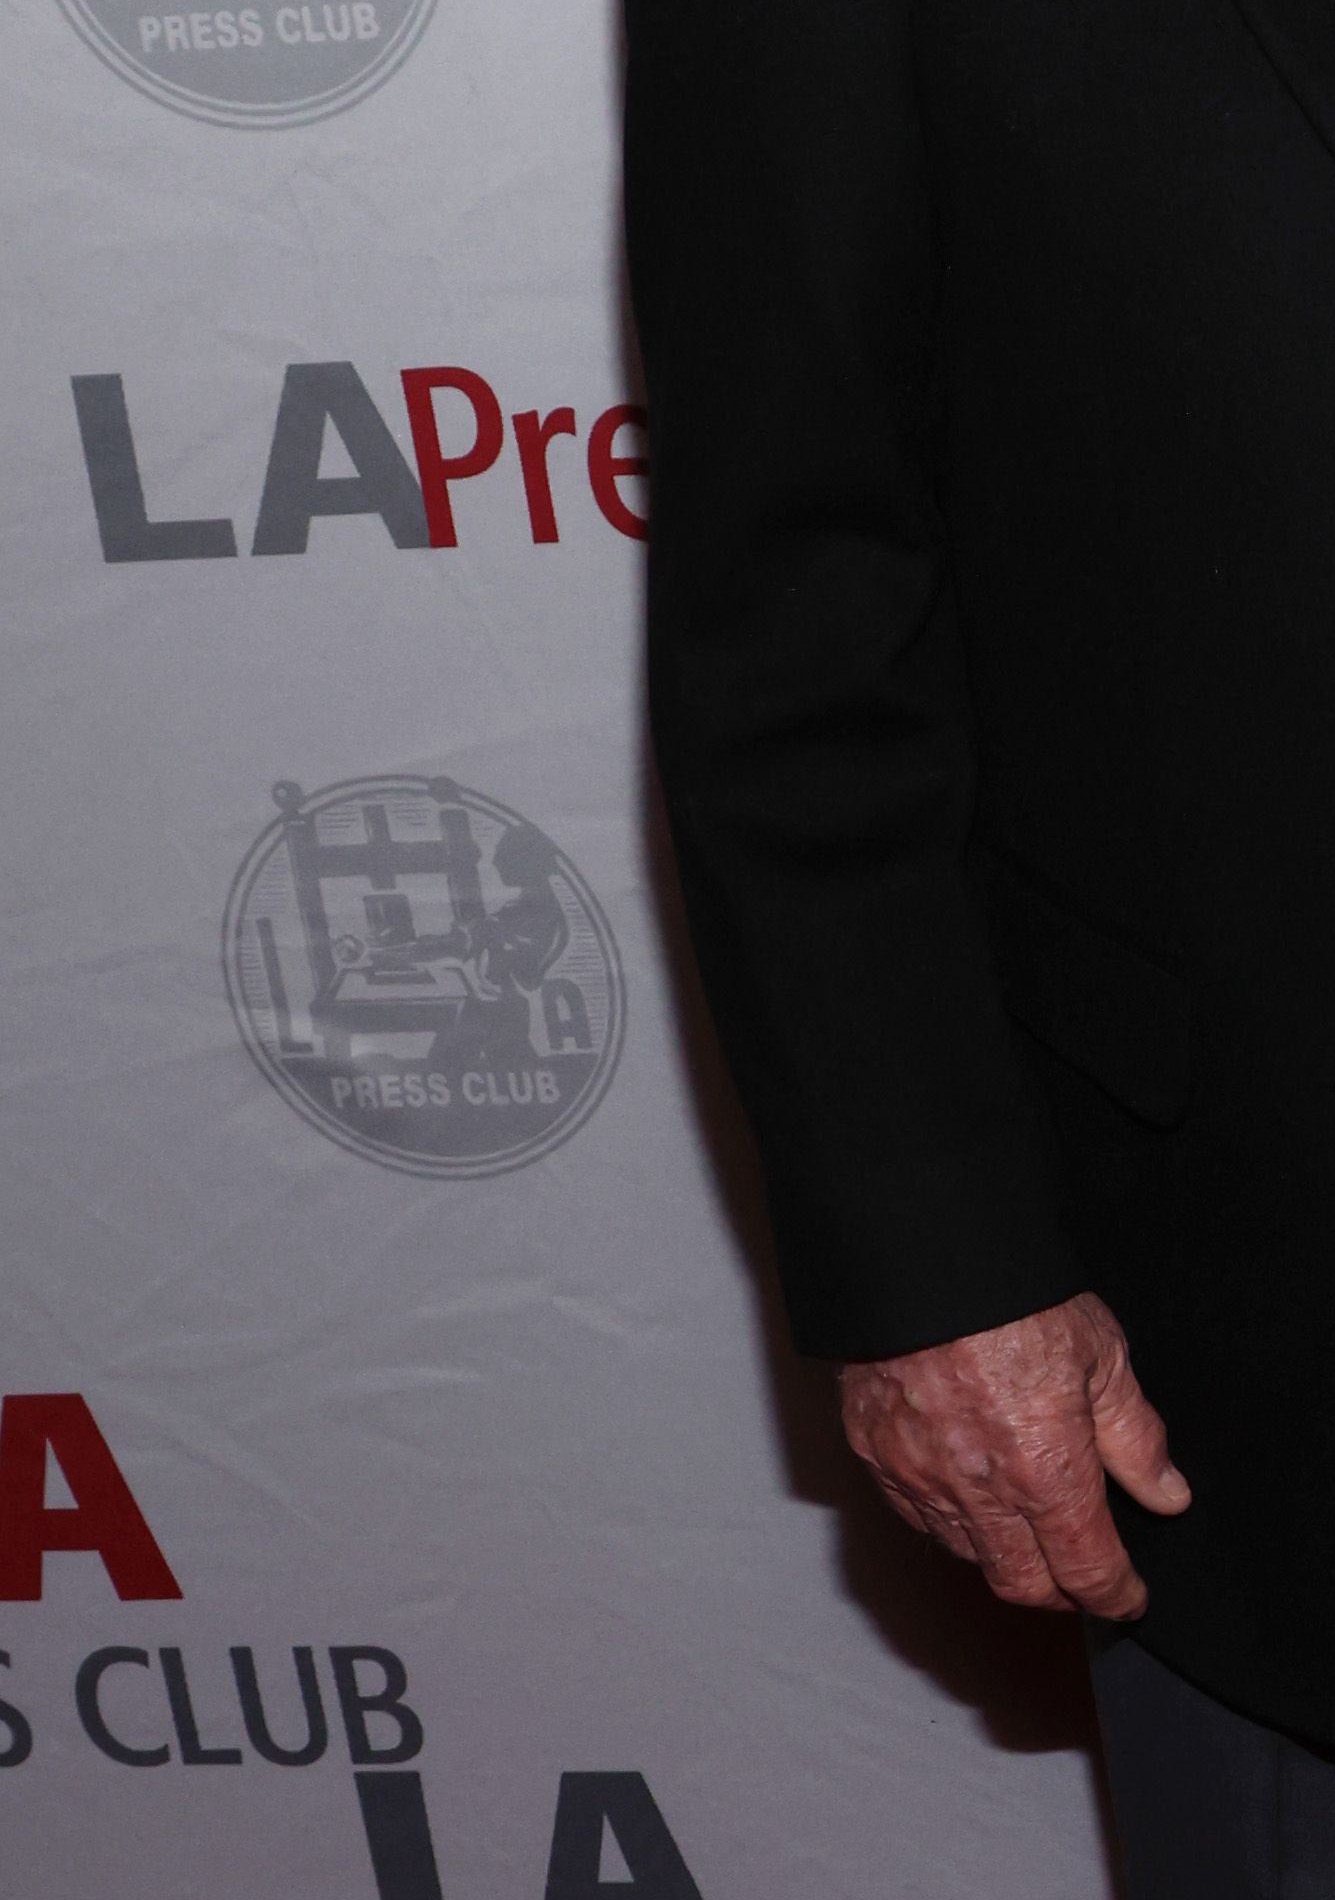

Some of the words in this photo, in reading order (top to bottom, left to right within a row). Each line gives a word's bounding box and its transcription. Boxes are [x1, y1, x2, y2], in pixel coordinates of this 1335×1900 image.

[138, 8, 264, 53] PRESS
[276, 1, 381, 44] CLUB
[330, 1072, 451, 1110] PRESS
[462, 1070, 561, 1106] CLUB
[0, 1392, 185, 1602] A
[74, 1645, 425, 1768] CLUB
